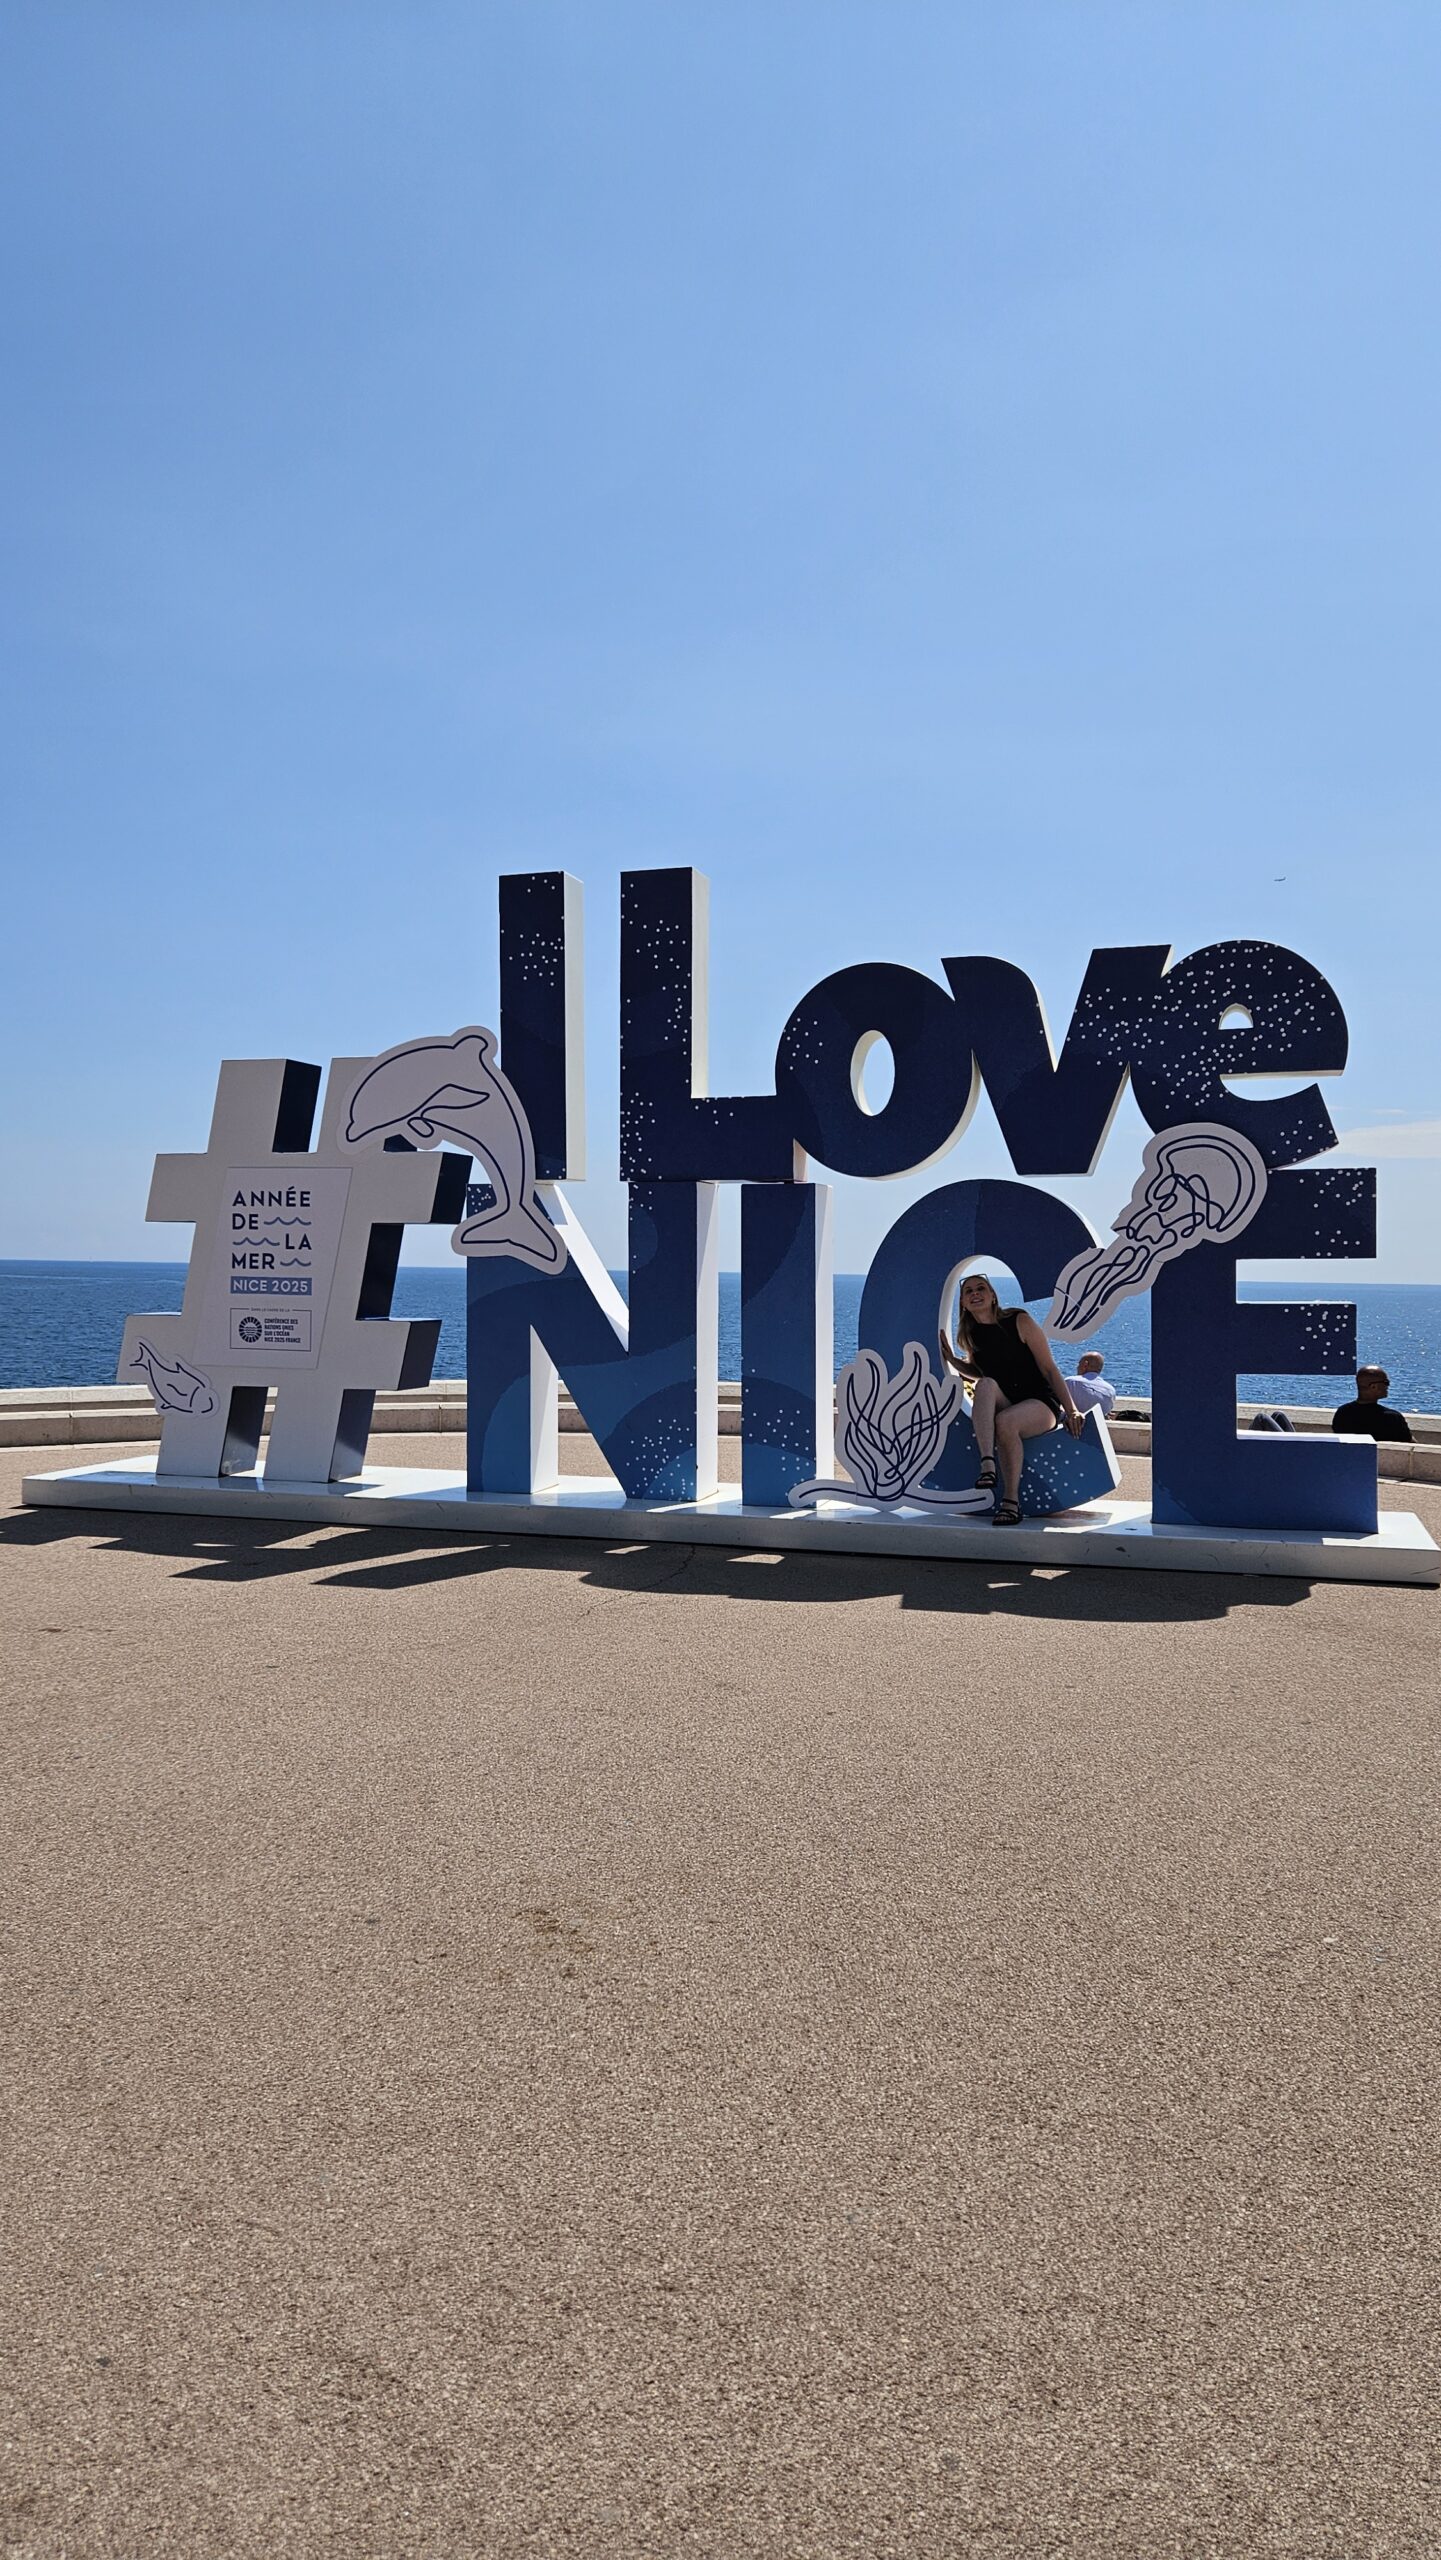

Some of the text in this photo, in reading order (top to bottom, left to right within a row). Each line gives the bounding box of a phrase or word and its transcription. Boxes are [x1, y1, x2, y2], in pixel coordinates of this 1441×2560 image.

[620, 867, 1349, 1182] Love
[232, 1186, 311, 1208] ANNÉE
[232, 1213, 259, 1230] DE
[285, 1233, 312, 1250] LA
[231, 1253, 275, 1270] MER
[233, 1279, 308, 1293] NICE 2025
[467, 1168, 1377, 1533] NICE
